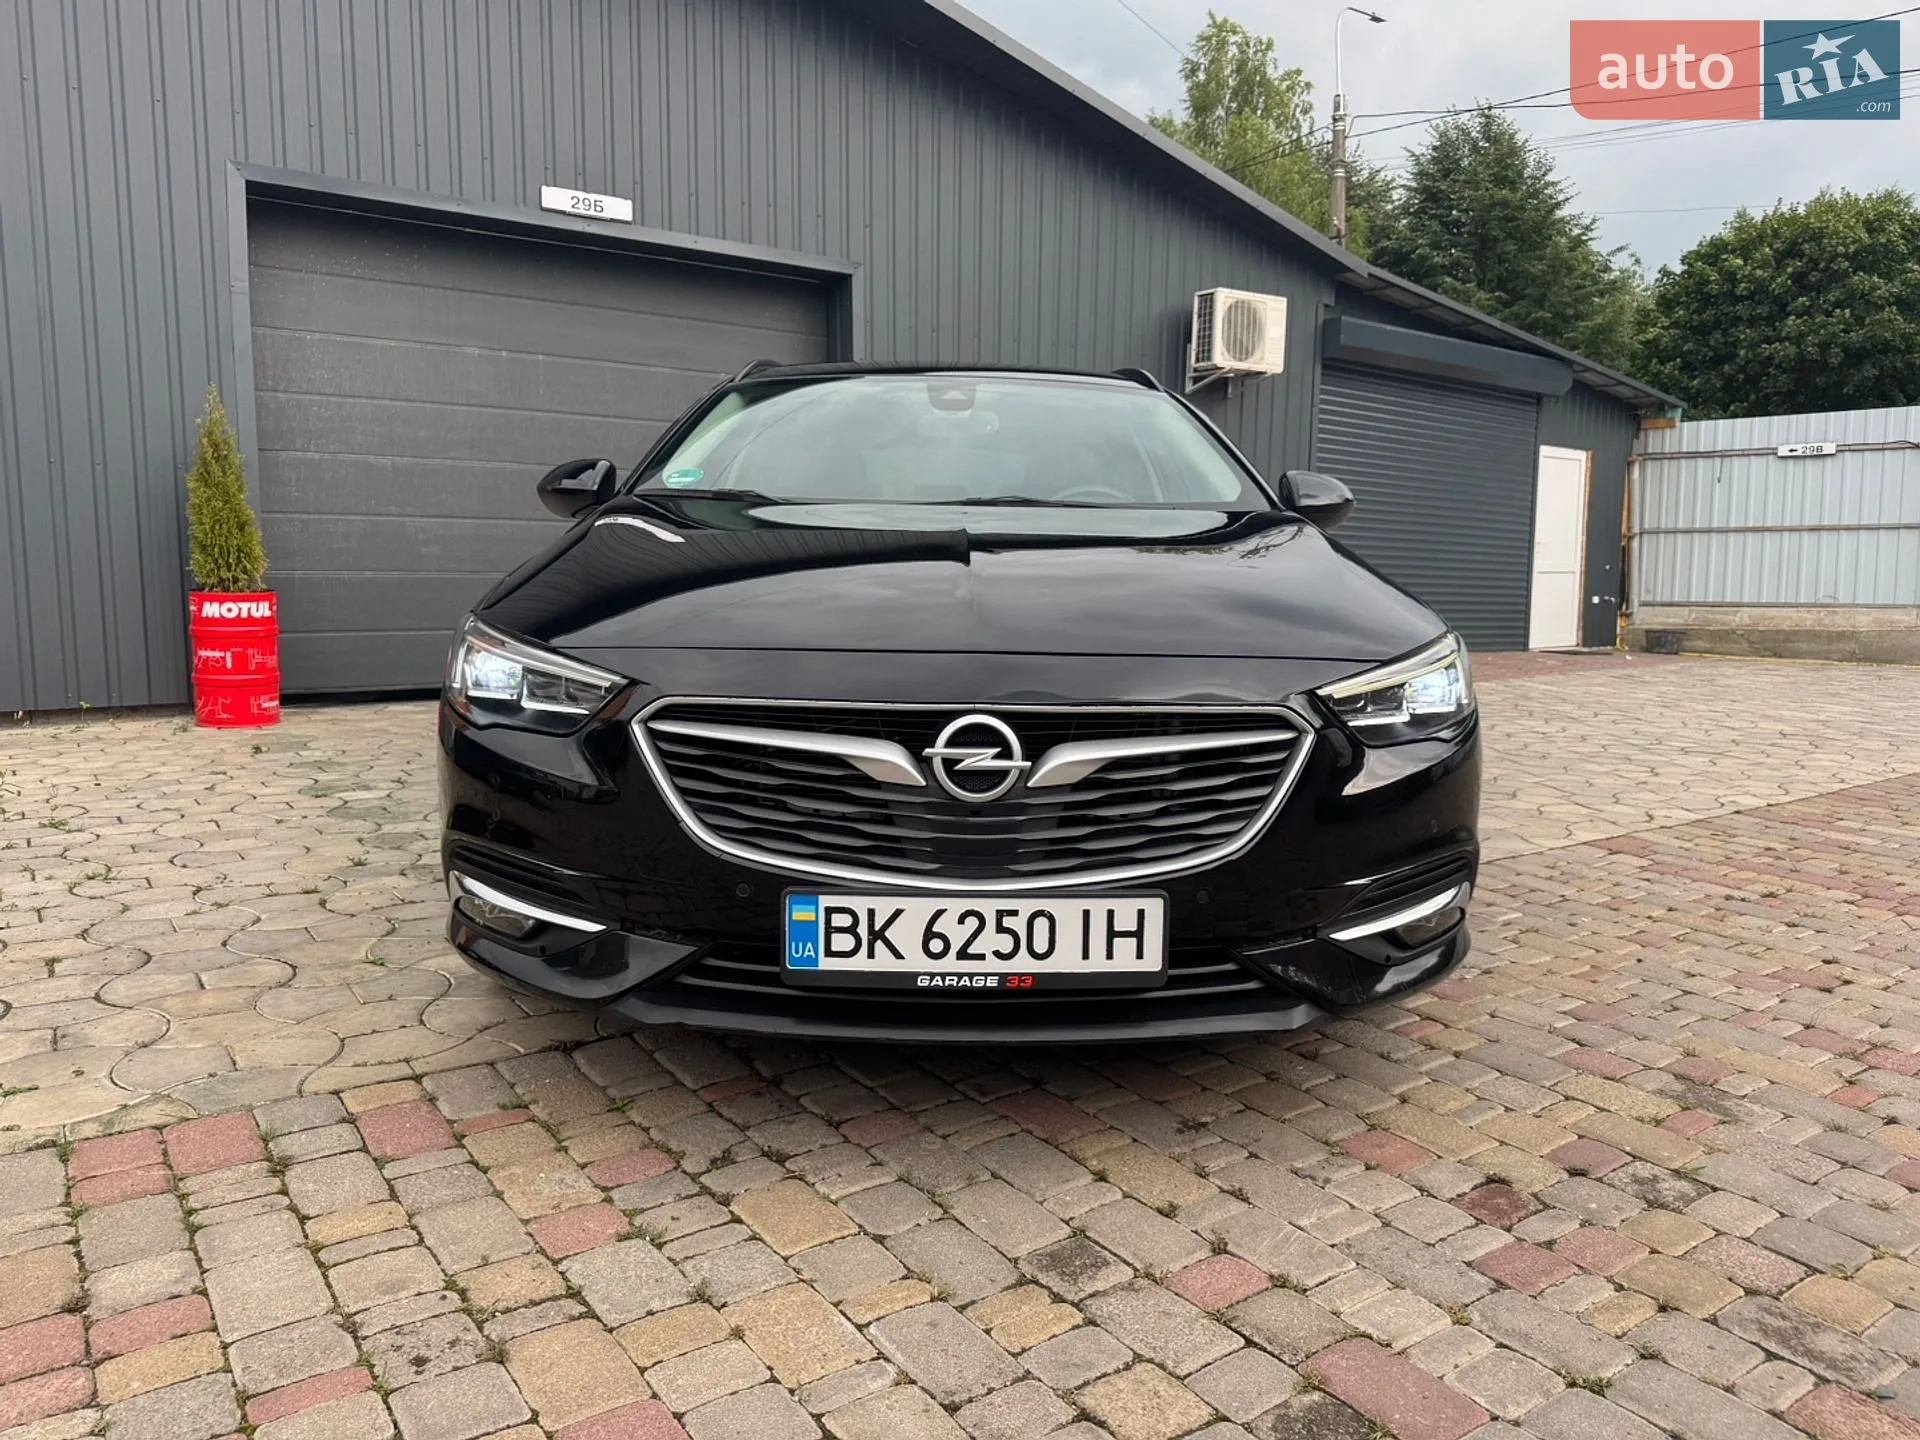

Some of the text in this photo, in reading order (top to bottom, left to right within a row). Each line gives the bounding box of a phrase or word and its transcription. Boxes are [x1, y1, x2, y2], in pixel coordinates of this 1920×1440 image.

[570, 195, 604, 213] 29Б
[201, 601, 272, 619] MOTUL
[823, 905, 1145, 961] BK 6250 IH
[791, 941, 816, 958] UA
[917, 975, 1034, 988] GARAGE 33
